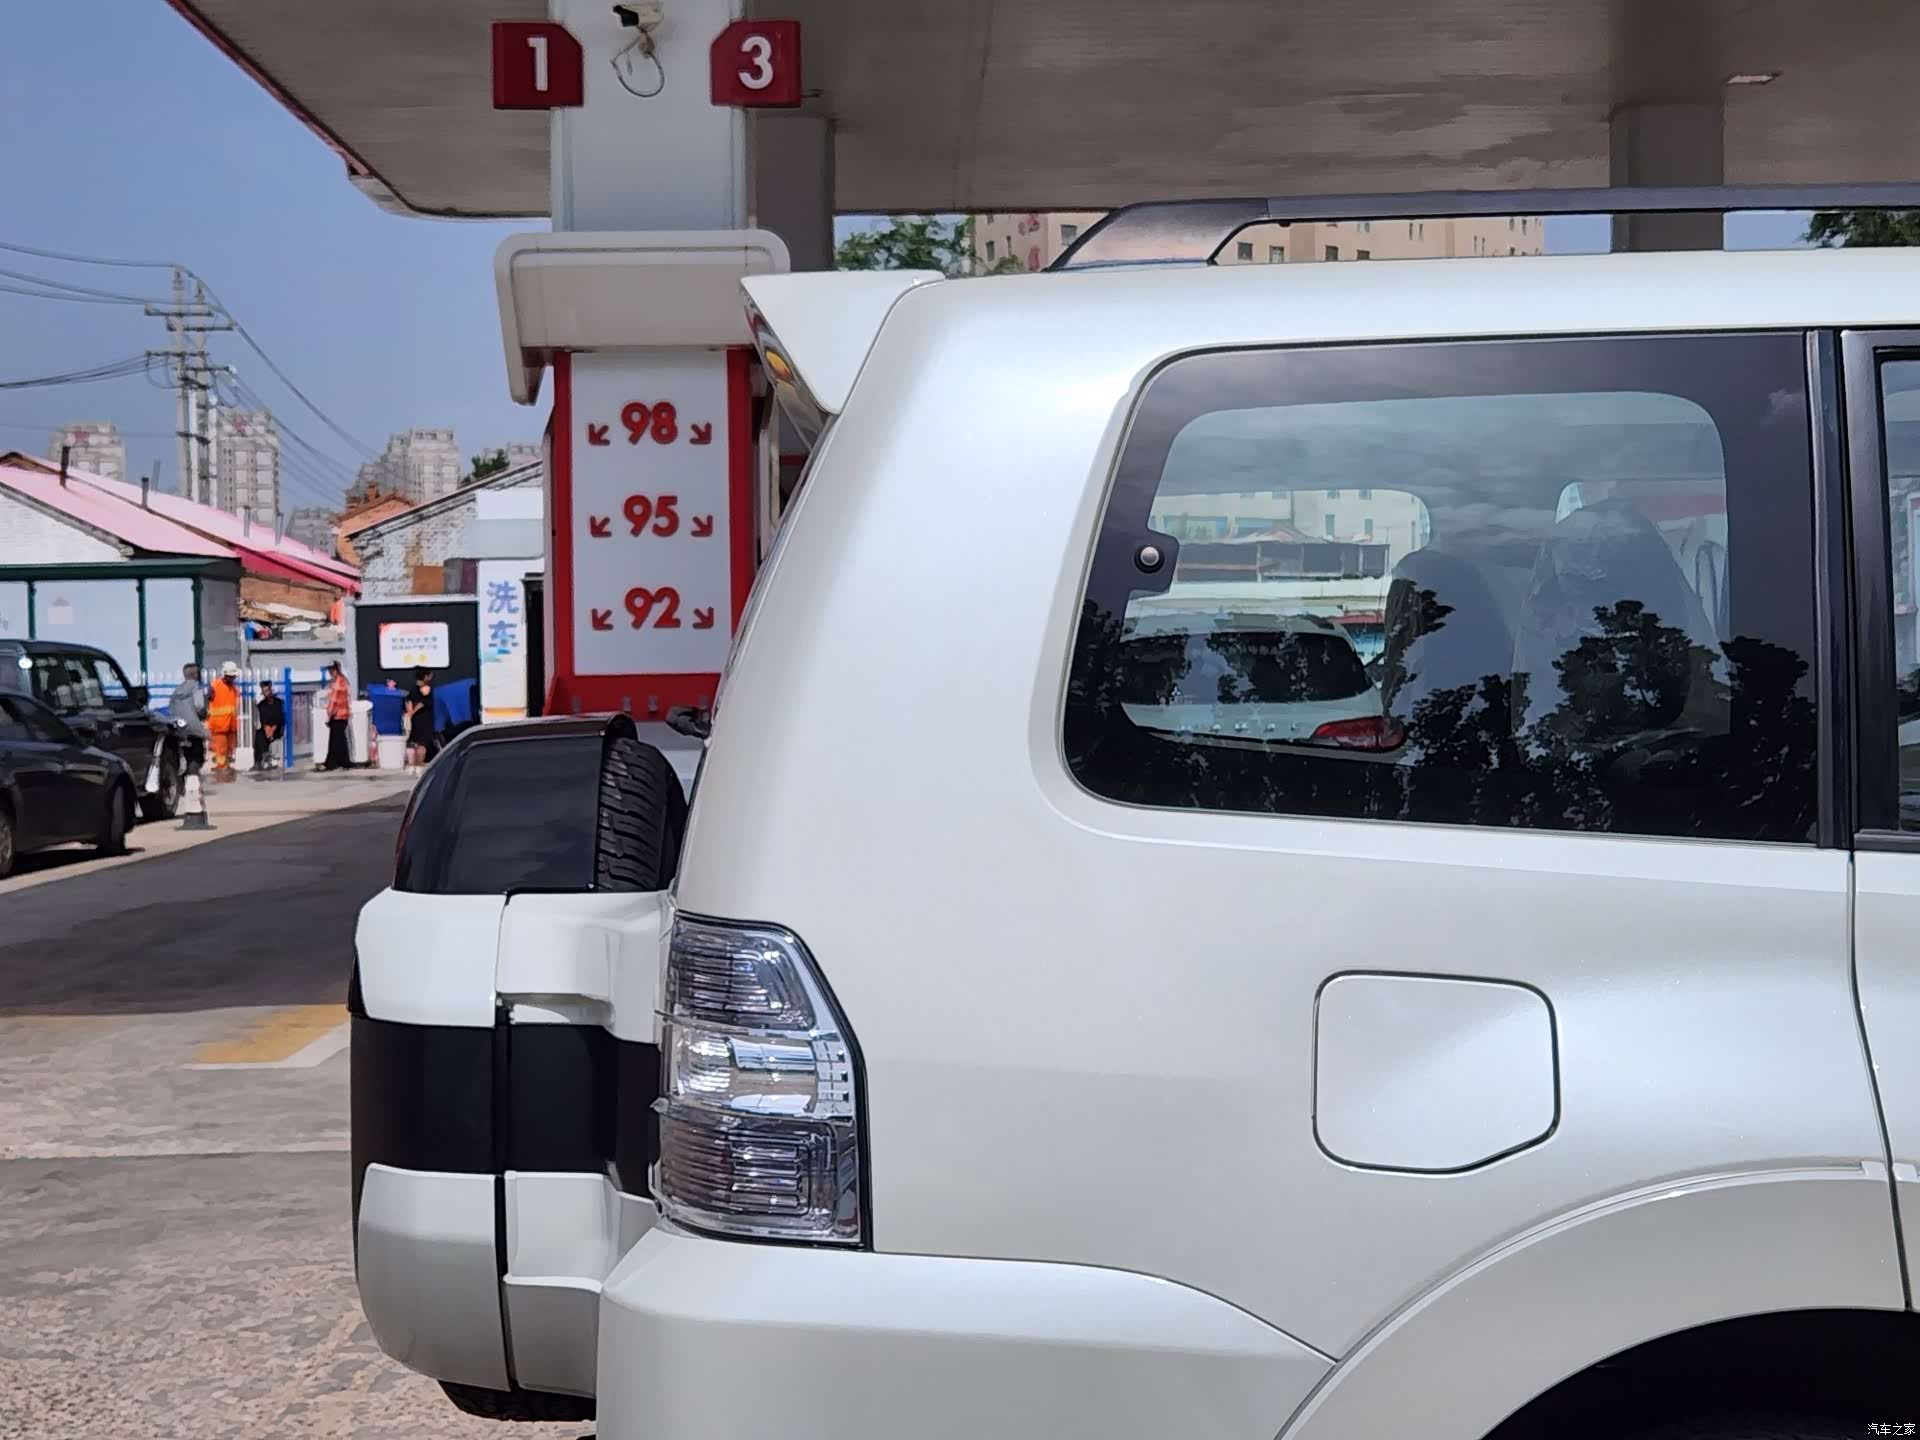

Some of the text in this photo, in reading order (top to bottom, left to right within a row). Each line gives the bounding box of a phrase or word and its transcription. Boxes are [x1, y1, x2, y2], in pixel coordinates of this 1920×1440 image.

[526, 36, 549, 92] 1
[737, 36, 774, 90] 3
[621, 402, 679, 445] 98
[623, 494, 680, 537] 95
[486, 580, 520, 651] 洗车
[624, 587, 681, 631] 92
